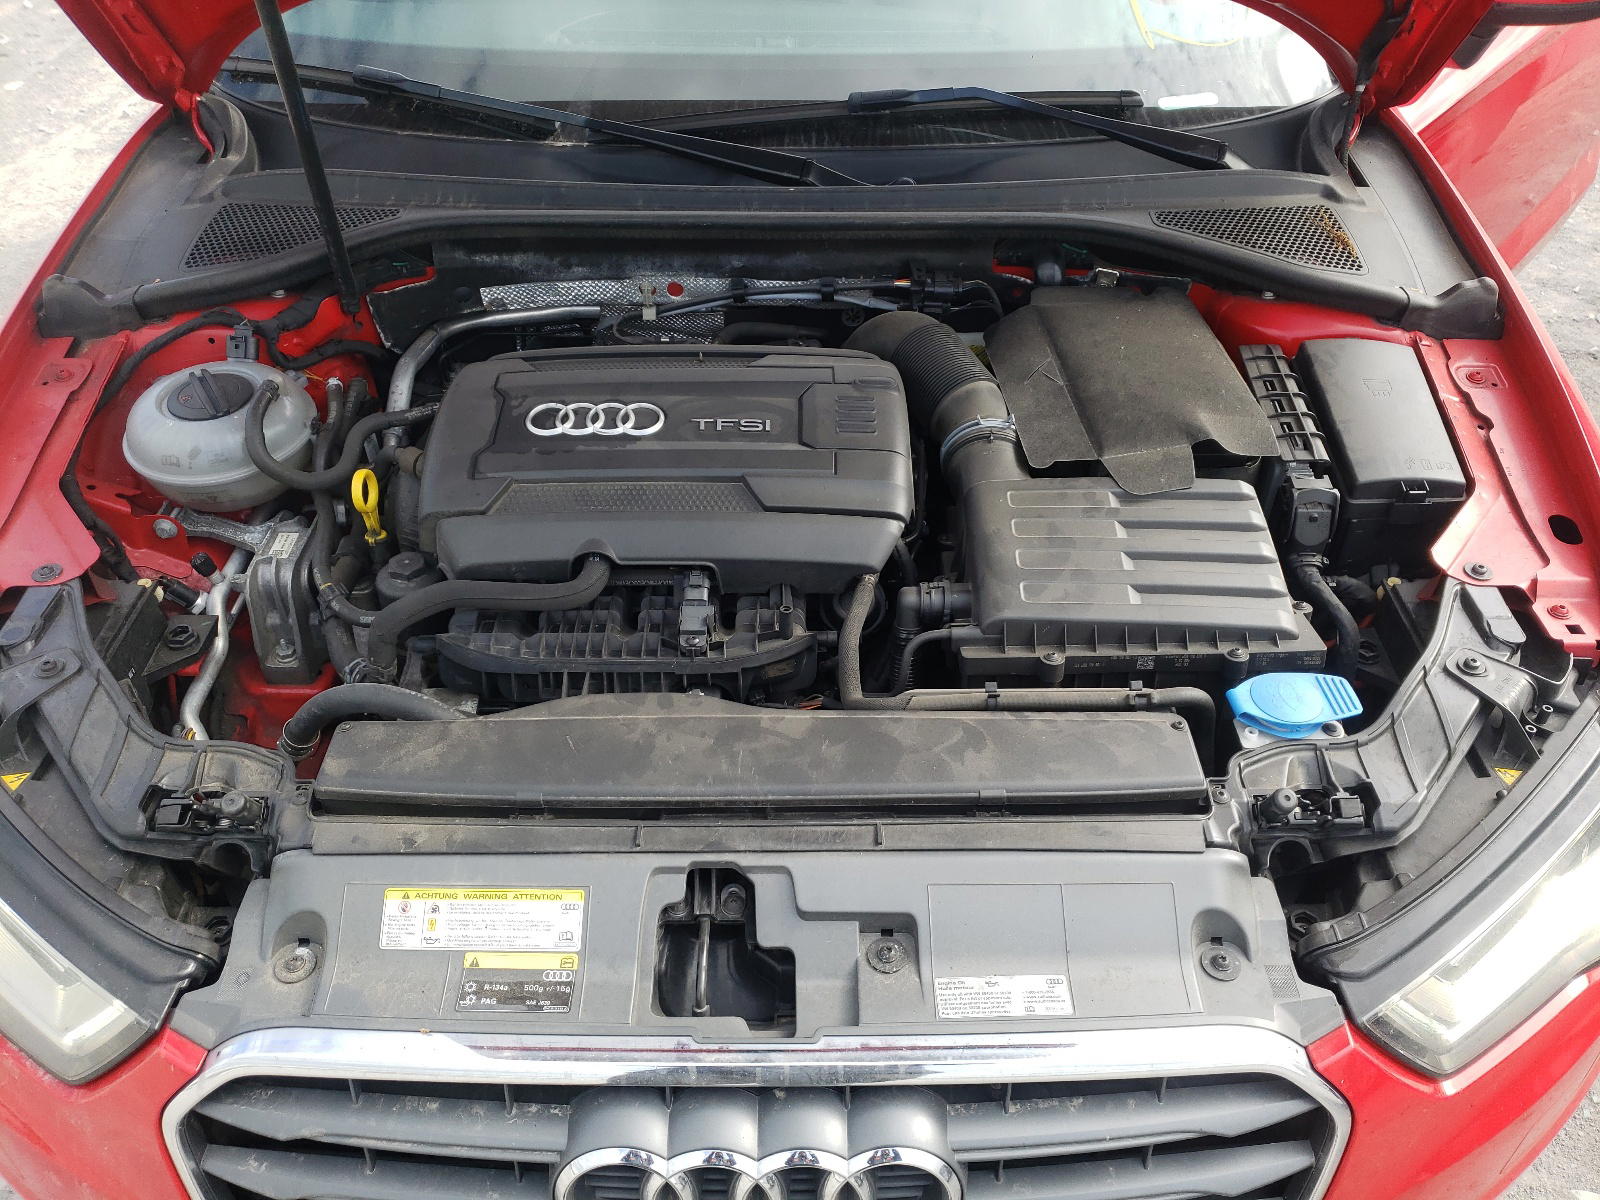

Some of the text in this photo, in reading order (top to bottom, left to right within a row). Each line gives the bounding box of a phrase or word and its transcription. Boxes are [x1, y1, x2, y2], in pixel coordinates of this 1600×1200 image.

[690, 418, 771, 432] TFSI
[414, 892, 563, 901] ACHTUNG WARNING ATTENTION
[523, 984, 544, 993] 500g
[480, 997, 497, 1005] PAG
